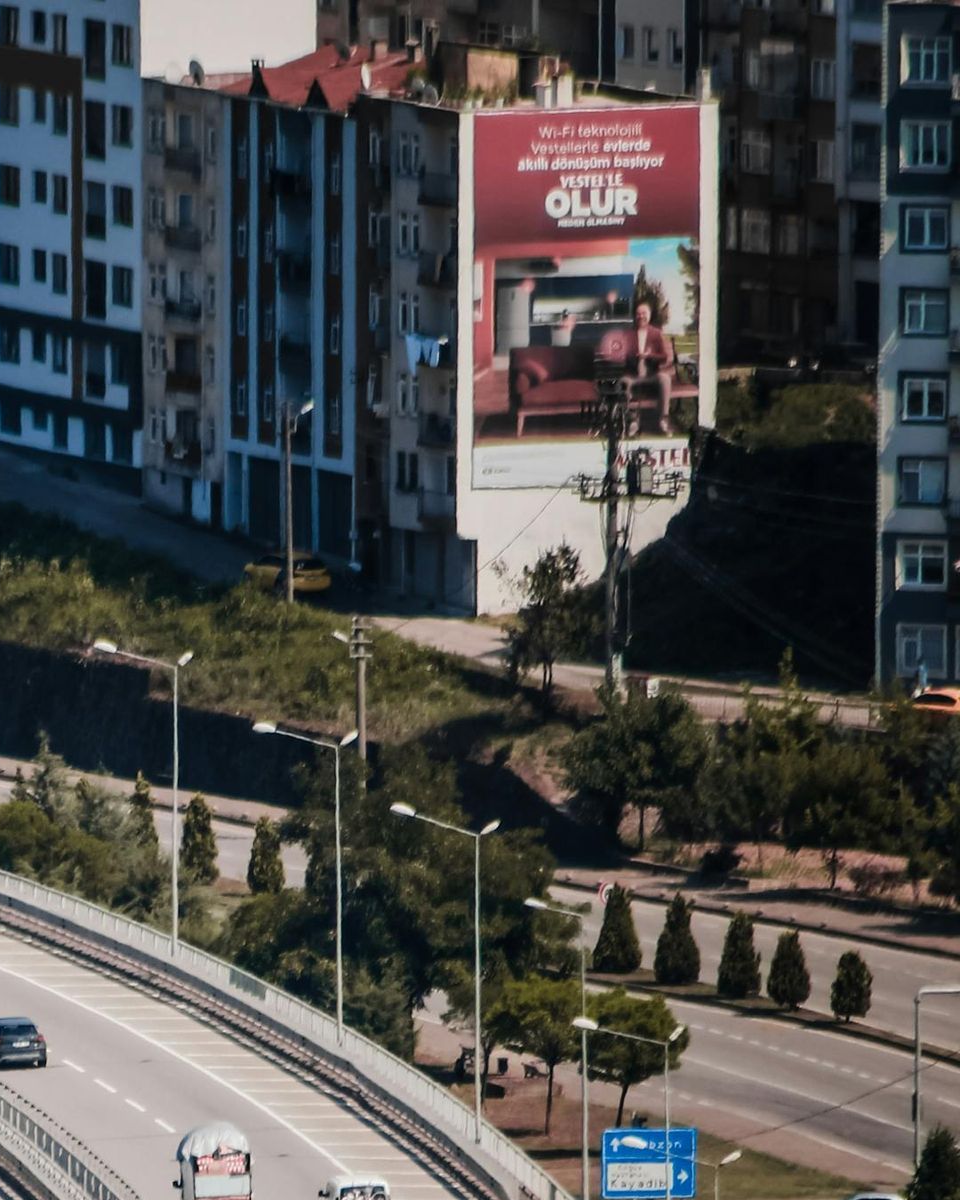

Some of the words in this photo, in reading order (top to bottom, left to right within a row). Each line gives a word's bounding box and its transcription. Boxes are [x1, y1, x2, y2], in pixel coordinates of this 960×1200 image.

[539, 126, 575, 139] Wi-Fi
[603, 138, 651, 153] evlerde
[551, 156, 610, 172] dönüşüm
[614, 154, 664, 171] başlıyor
[559, 174, 624, 189] VESTEL'LE
[545, 188, 638, 219] OLUR
